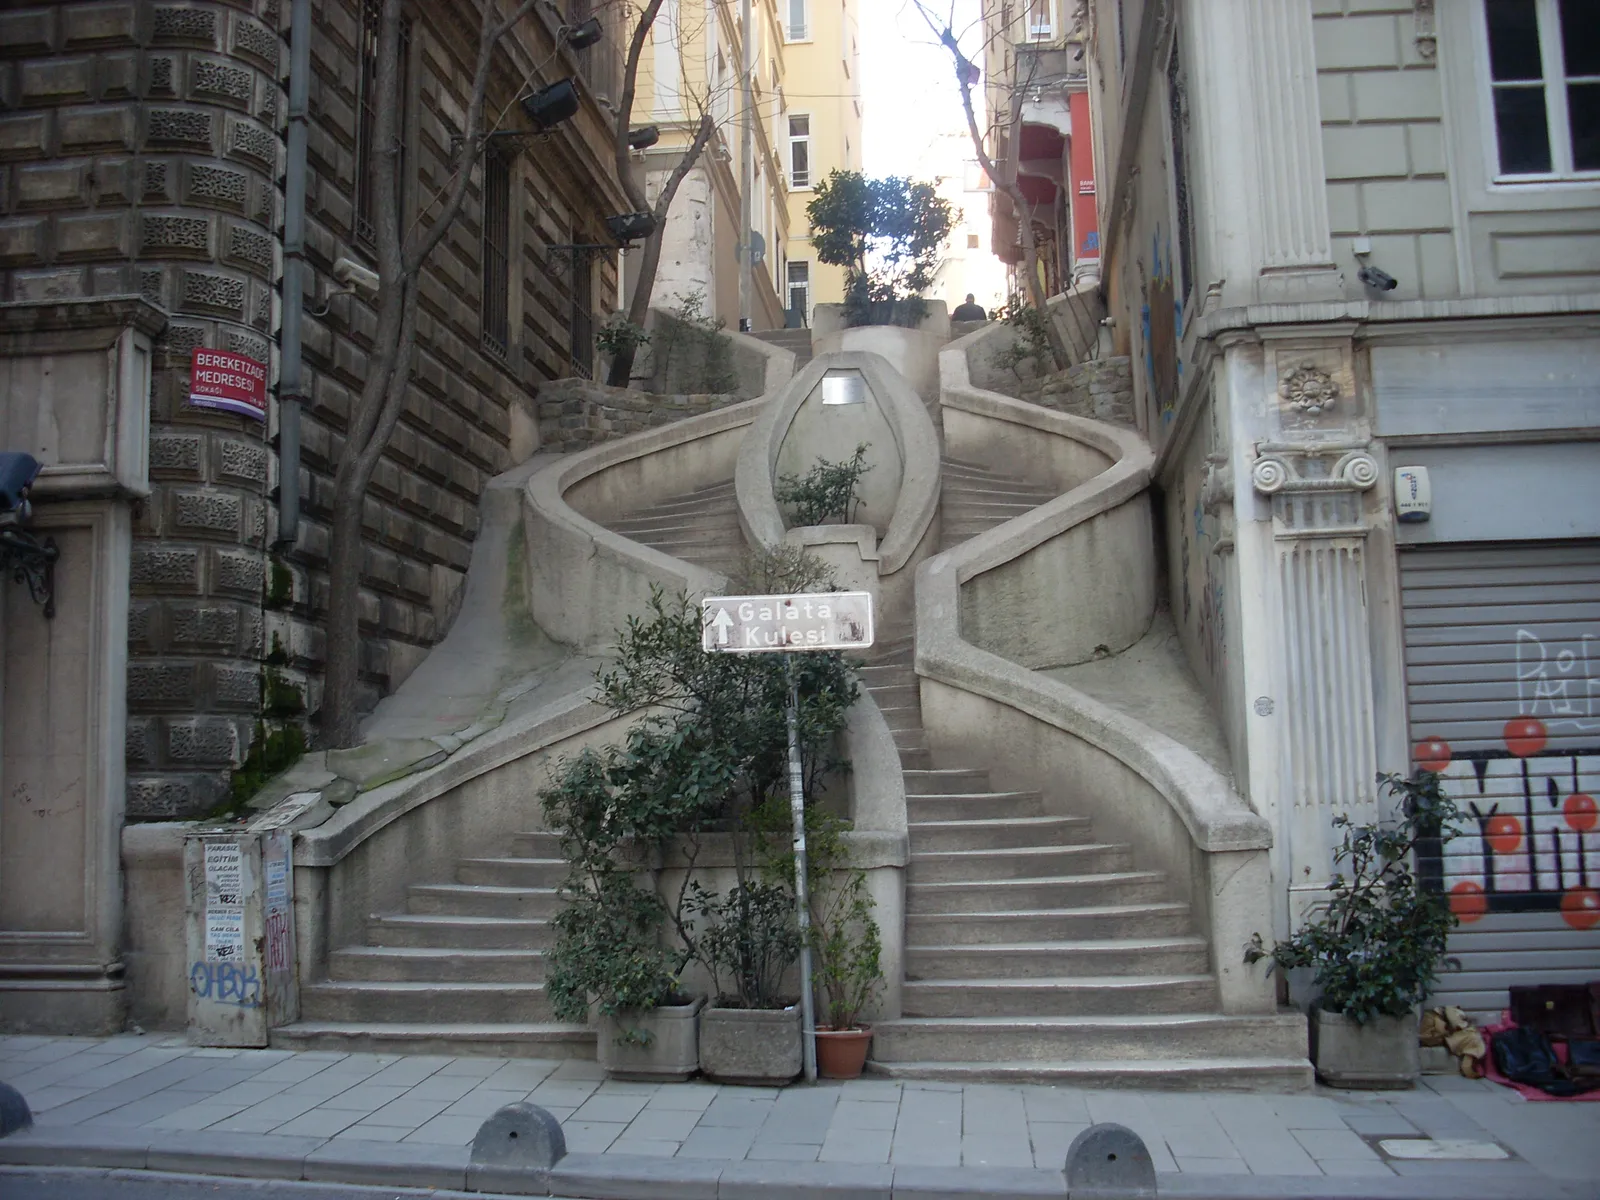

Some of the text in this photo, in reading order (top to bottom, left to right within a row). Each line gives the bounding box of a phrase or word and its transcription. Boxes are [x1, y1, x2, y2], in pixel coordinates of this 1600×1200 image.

[197, 353, 265, 381] BEREKETZADE
[196, 370, 255, 393] MEDRESESİ
[738, 602, 832, 621] Galata
[745, 626, 826, 646] Kulesi
